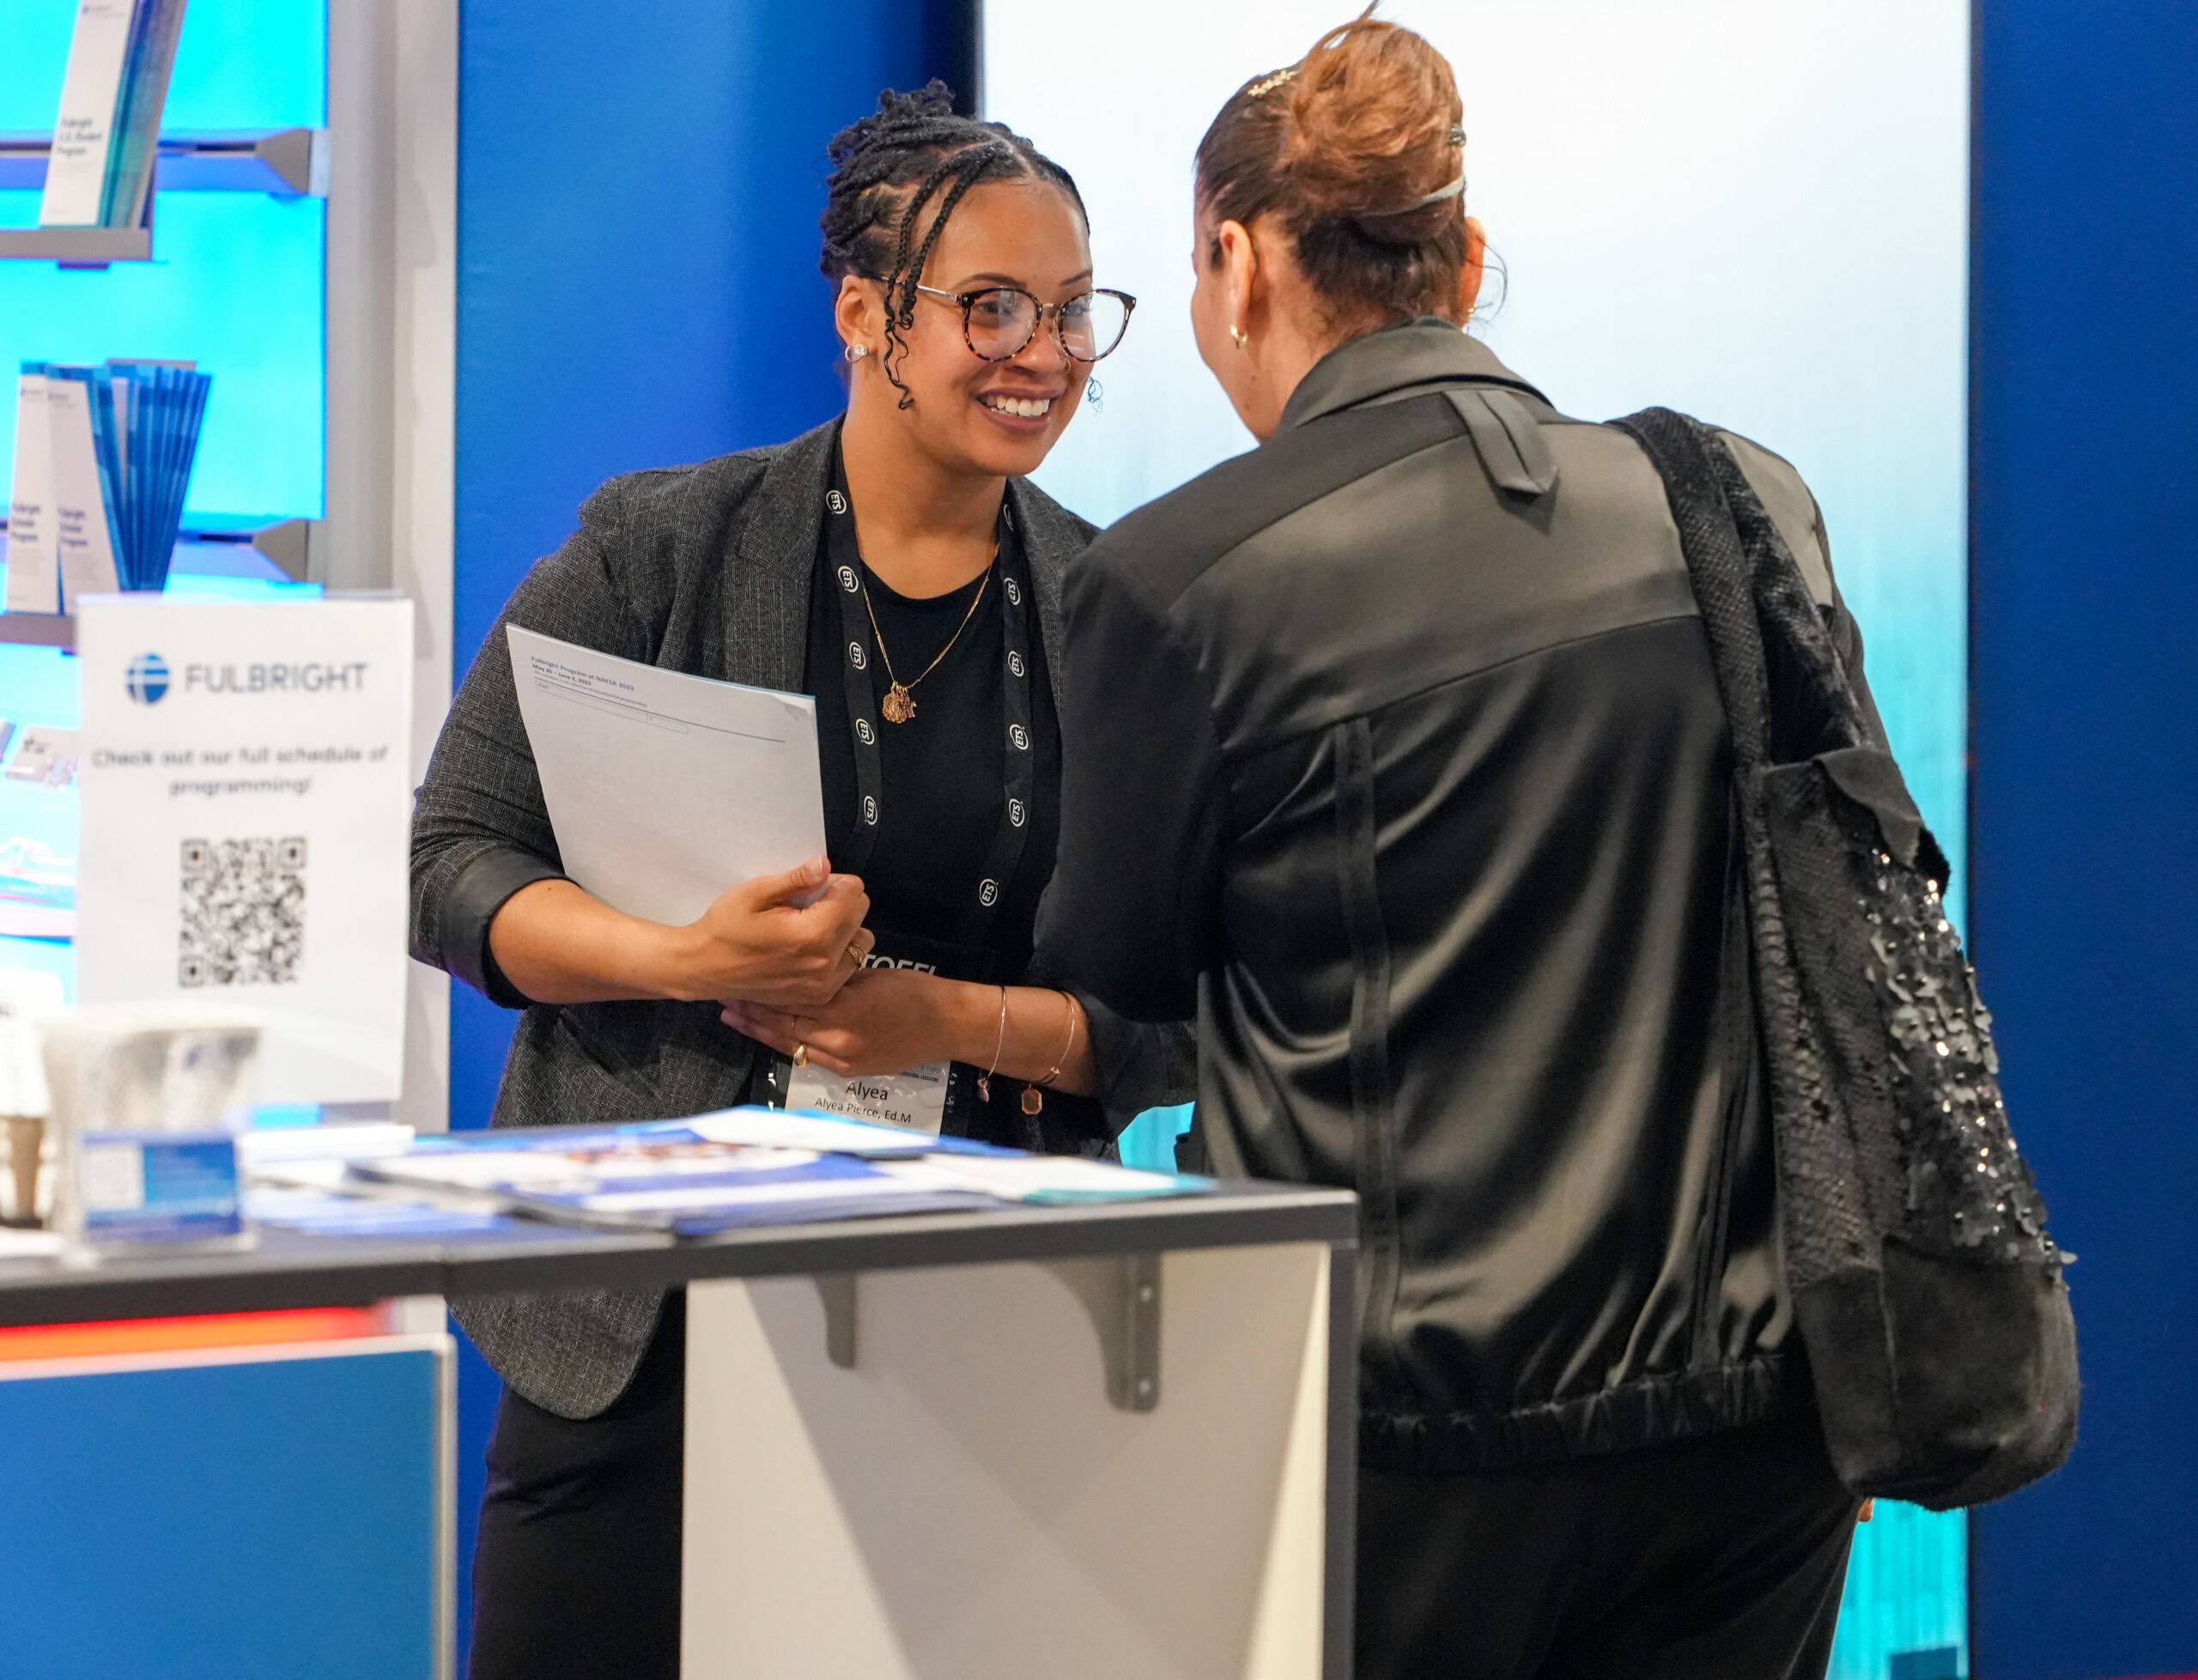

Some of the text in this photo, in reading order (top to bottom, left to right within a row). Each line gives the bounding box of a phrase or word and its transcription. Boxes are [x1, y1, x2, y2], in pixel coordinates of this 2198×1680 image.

[185, 663, 367, 693] FULBRIGHT
[92, 745, 389, 768] Check out our full schedule of
[169, 777, 312, 798] programming!
[846, 1081, 889, 1101] Alyea
[815, 1098, 912, 1124] Alyea Pierce, Ed.M
